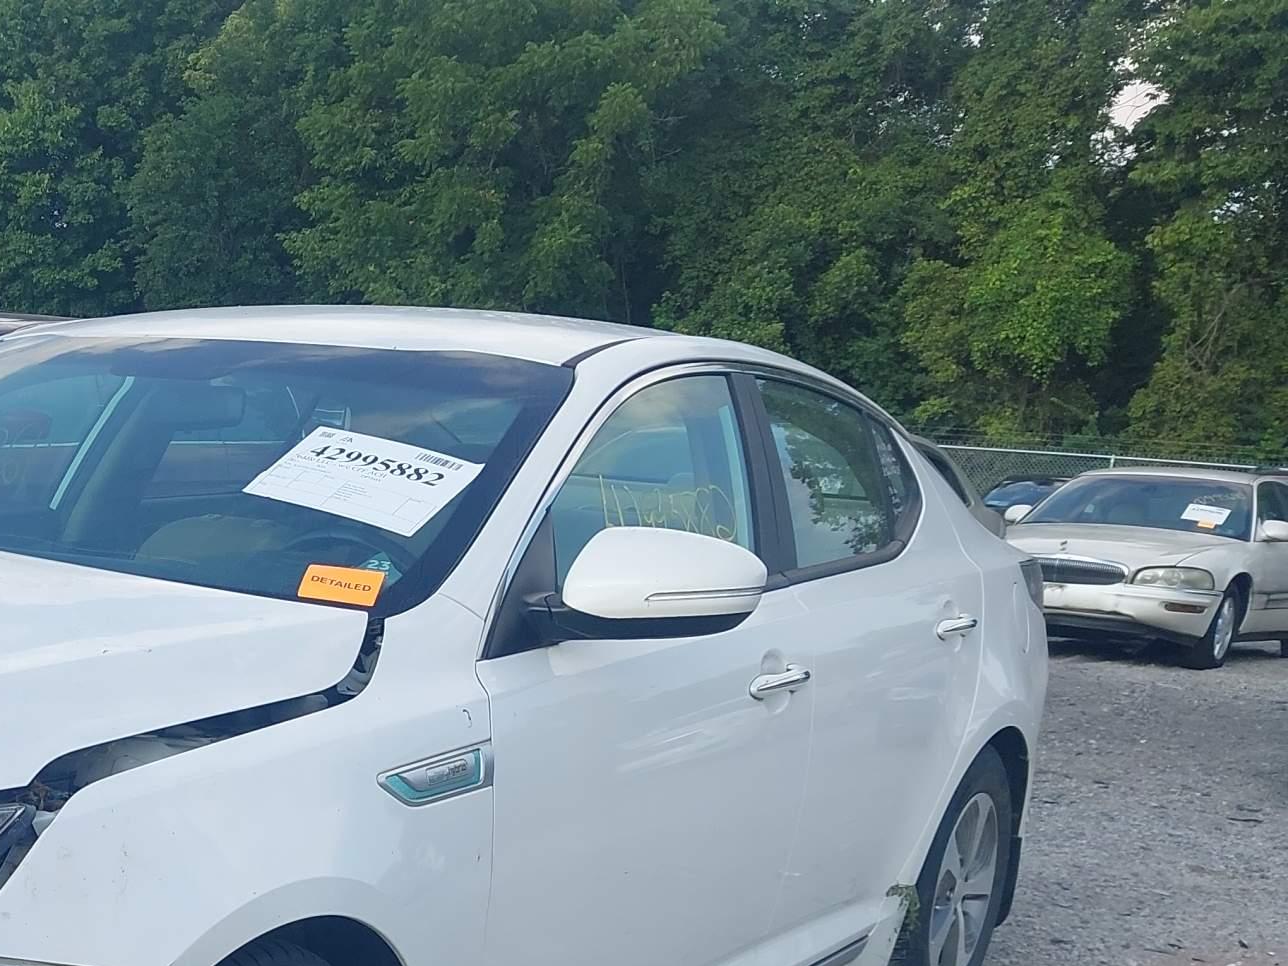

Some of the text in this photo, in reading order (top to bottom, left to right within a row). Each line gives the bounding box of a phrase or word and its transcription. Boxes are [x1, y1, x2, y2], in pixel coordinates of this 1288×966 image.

[310, 444, 445, 487] 42995882
[367, 559, 392, 571] 23
[310, 575, 372, 592] DETAILED
